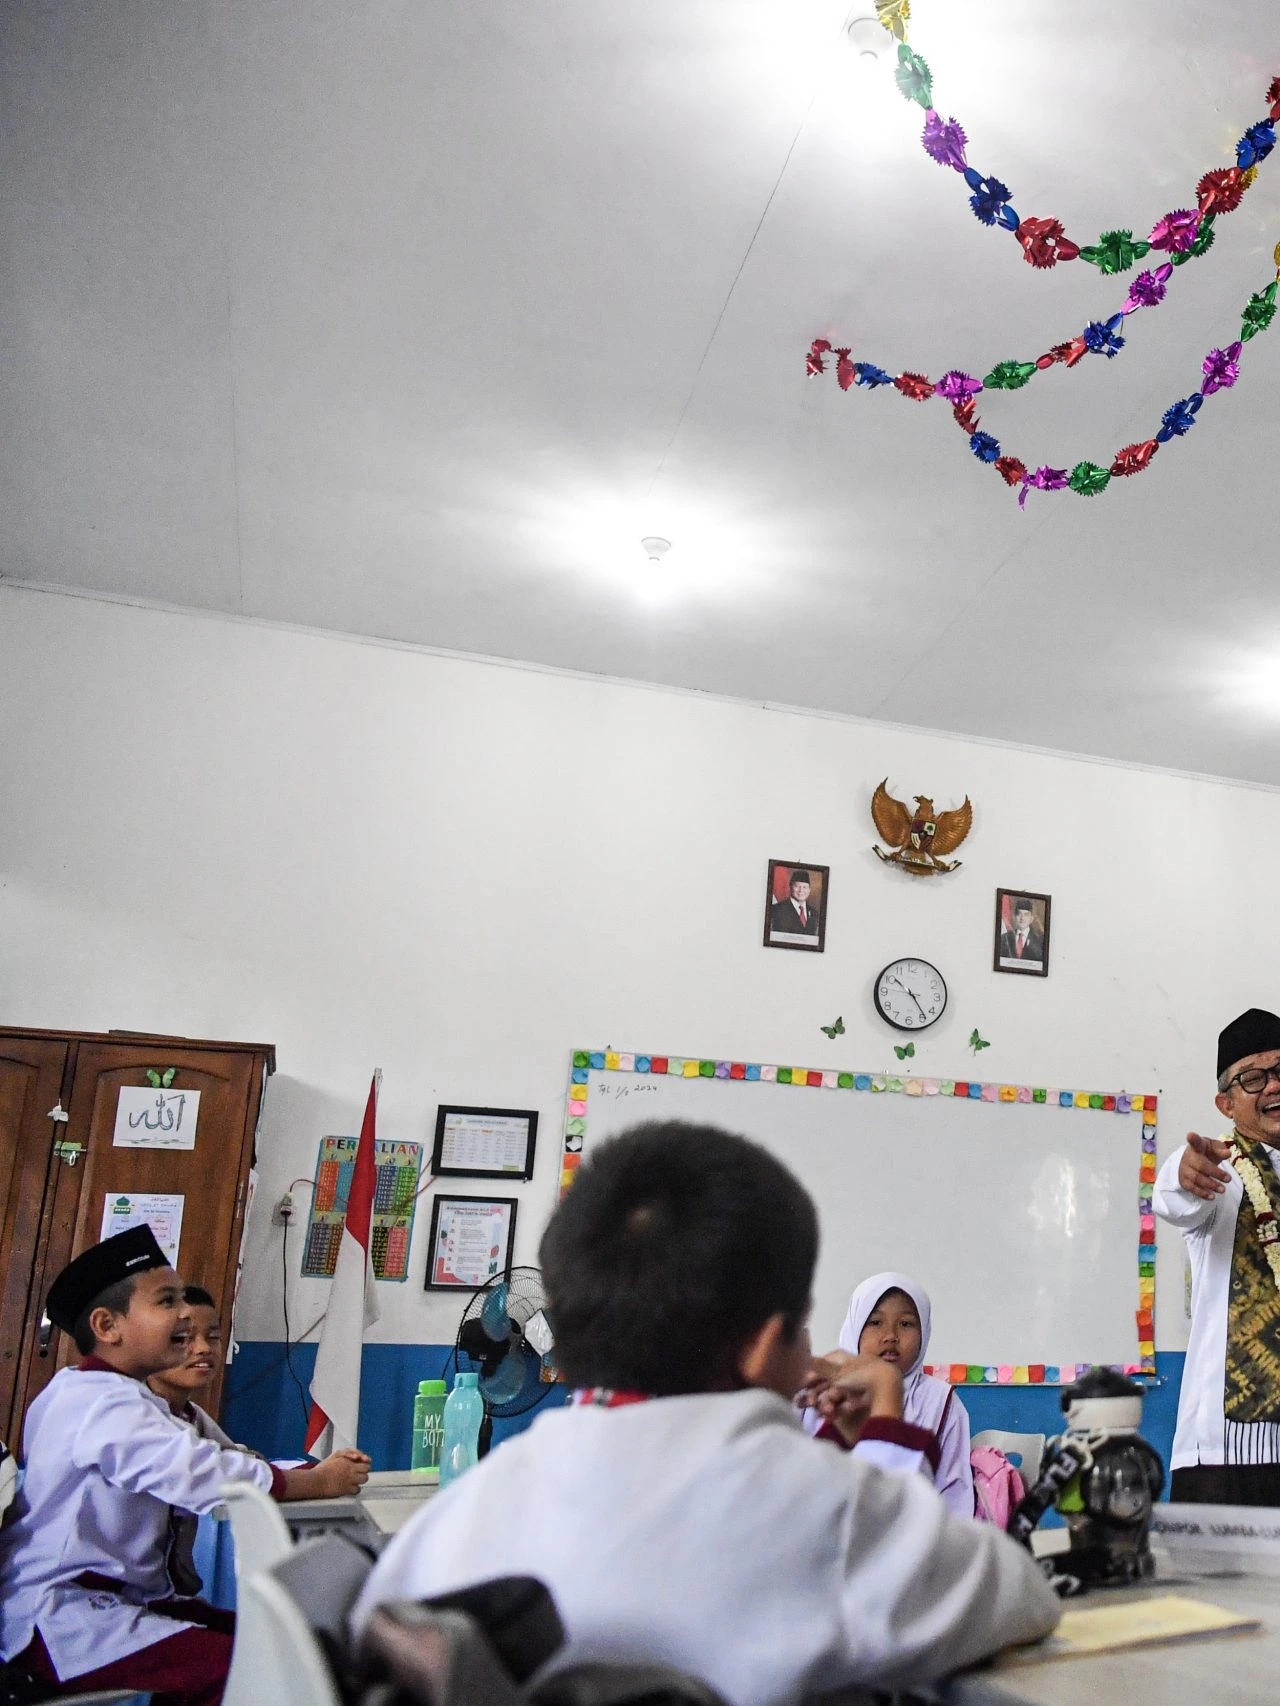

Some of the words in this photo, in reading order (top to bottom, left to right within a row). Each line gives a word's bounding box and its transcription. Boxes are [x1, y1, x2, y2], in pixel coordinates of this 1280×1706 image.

[896, 967, 903, 975] 11
[908, 963, 918, 974] 12
[885, 975, 896, 984] 10
[930, 980, 937, 990] 2
[880, 986, 888, 996] 9
[933, 993, 941, 1002] 3
[884, 1001, 892, 1011] 8
[928, 1006, 936, 1015] 4
[893, 1011, 900, 1020] 7
[919, 1013, 926, 1023] 5
[905, 1016, 913, 1026] 6
[325, 1139, 419, 1155] PERLIAN
[424, 1413, 441, 1430] MY
[422, 1430, 445, 1448] BOTT
